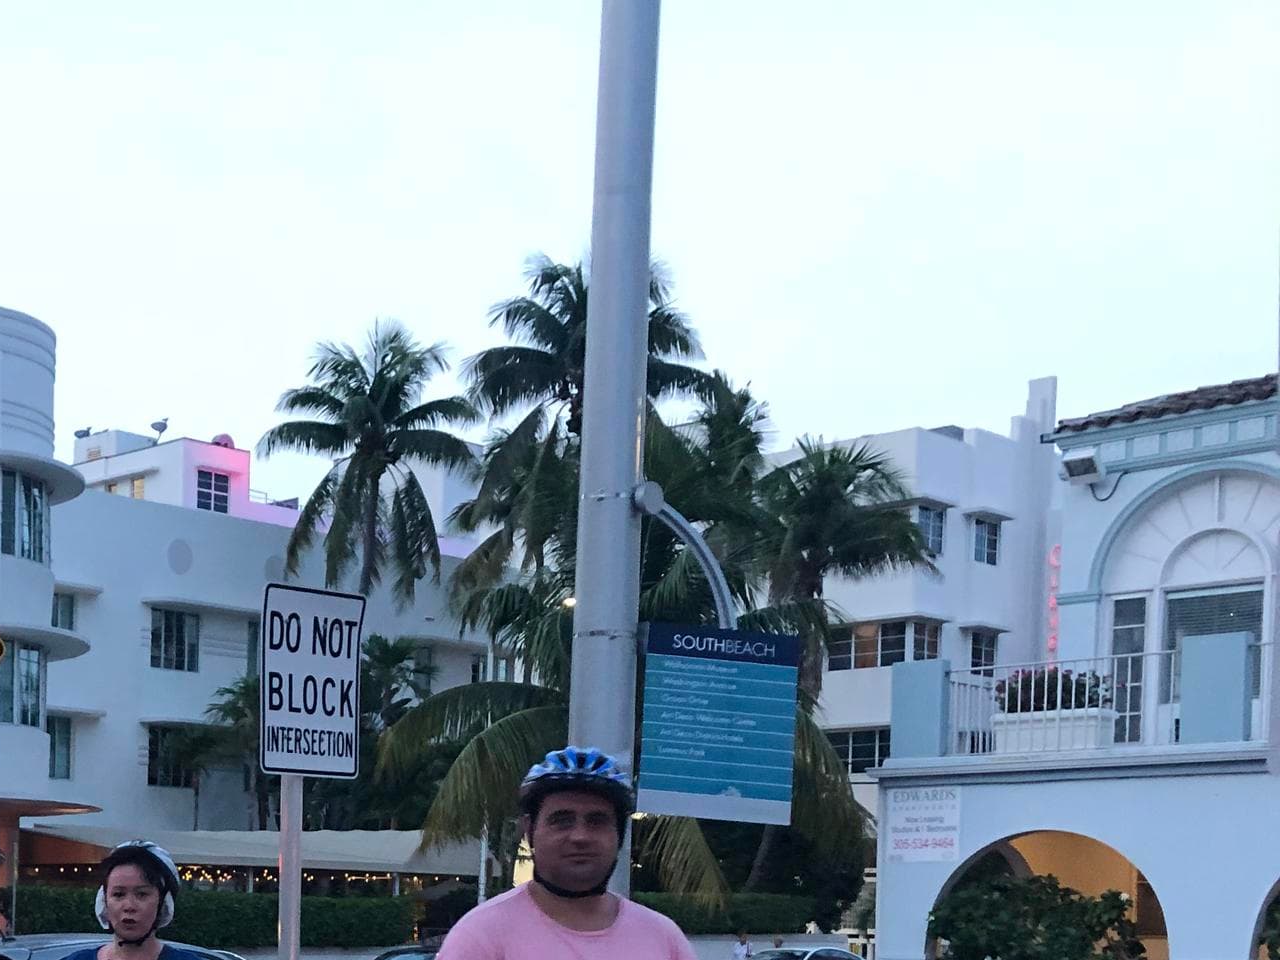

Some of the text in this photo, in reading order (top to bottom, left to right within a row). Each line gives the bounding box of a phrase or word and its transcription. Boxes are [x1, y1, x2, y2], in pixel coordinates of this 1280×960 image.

[269, 610, 358, 659] DO NOT
[268, 671, 354, 718] BLOCK
[267, 725, 353, 758] INTERSECTION
[893, 790, 956, 803] EDWARDS
